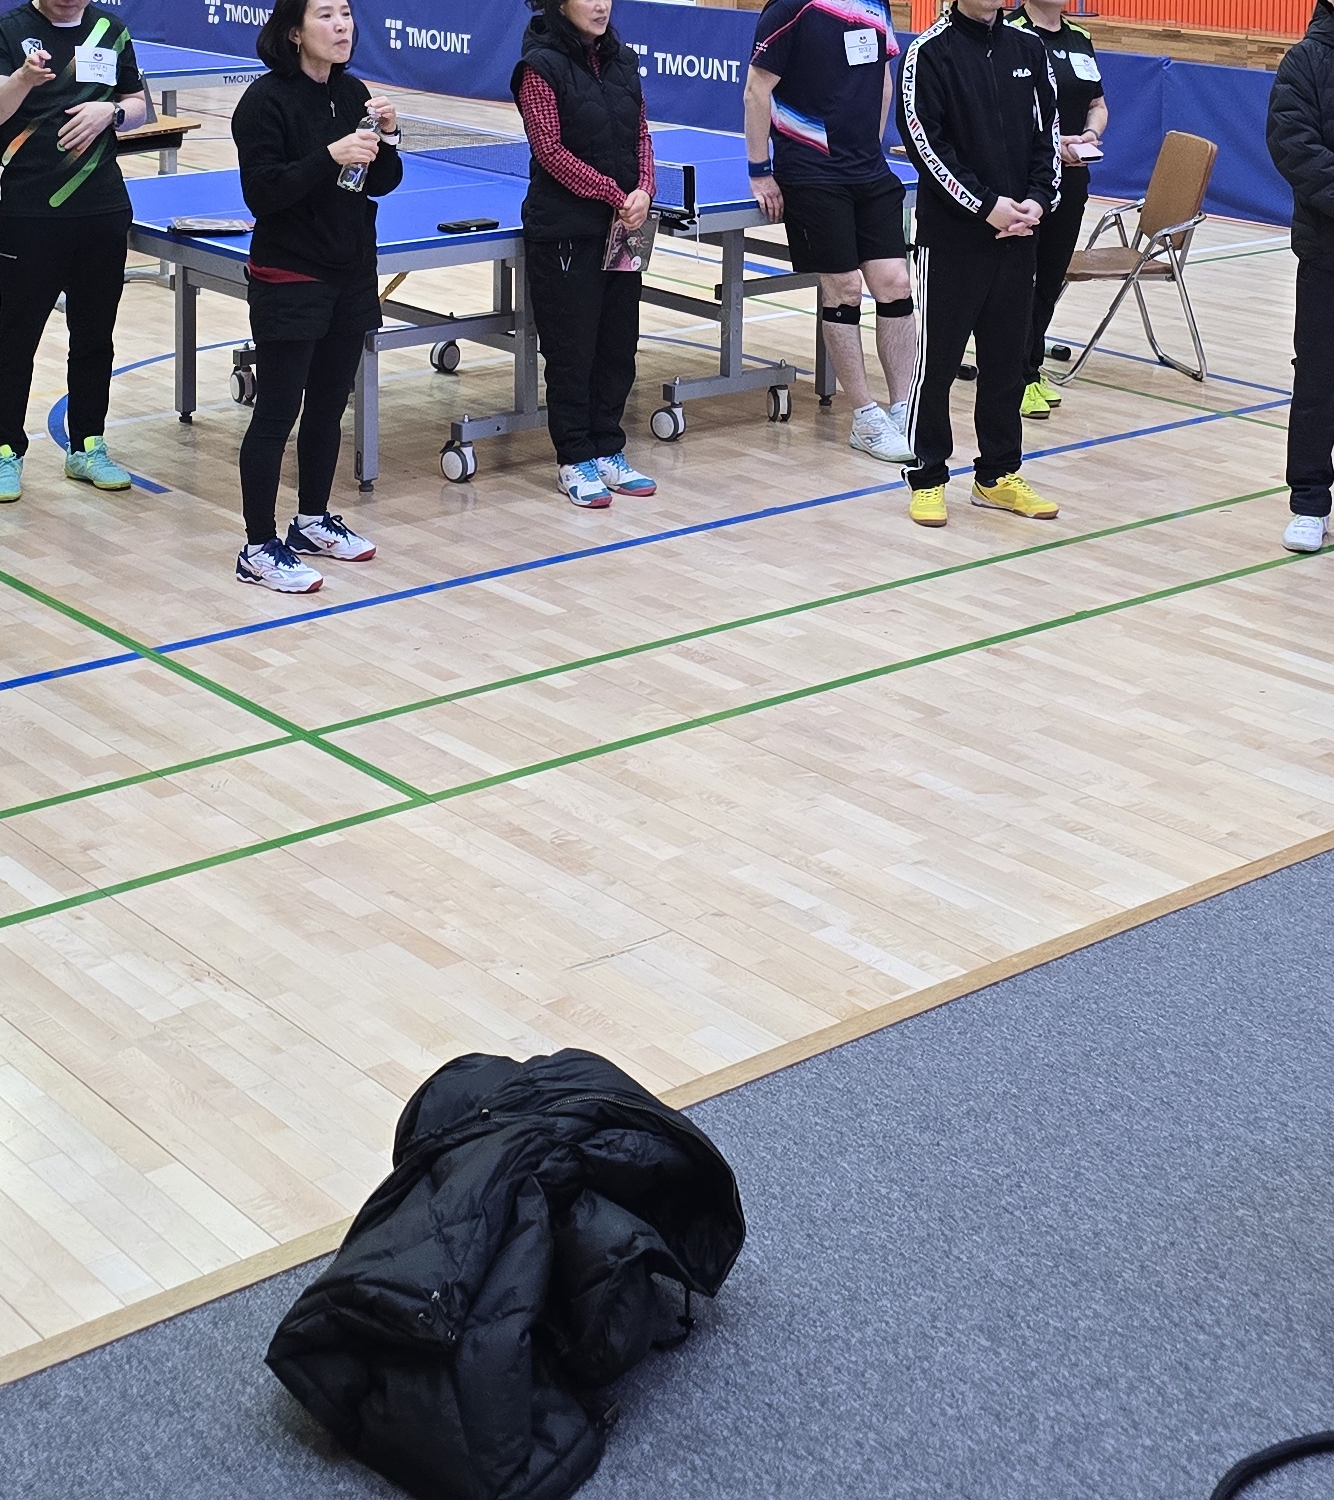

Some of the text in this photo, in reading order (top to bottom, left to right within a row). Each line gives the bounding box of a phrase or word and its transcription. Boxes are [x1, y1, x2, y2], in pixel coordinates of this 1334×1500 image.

[405, 26, 471, 54] TMOUNT
[653, 51, 740, 83] TMOUNT
[1012, 67, 1032, 78] FILA
